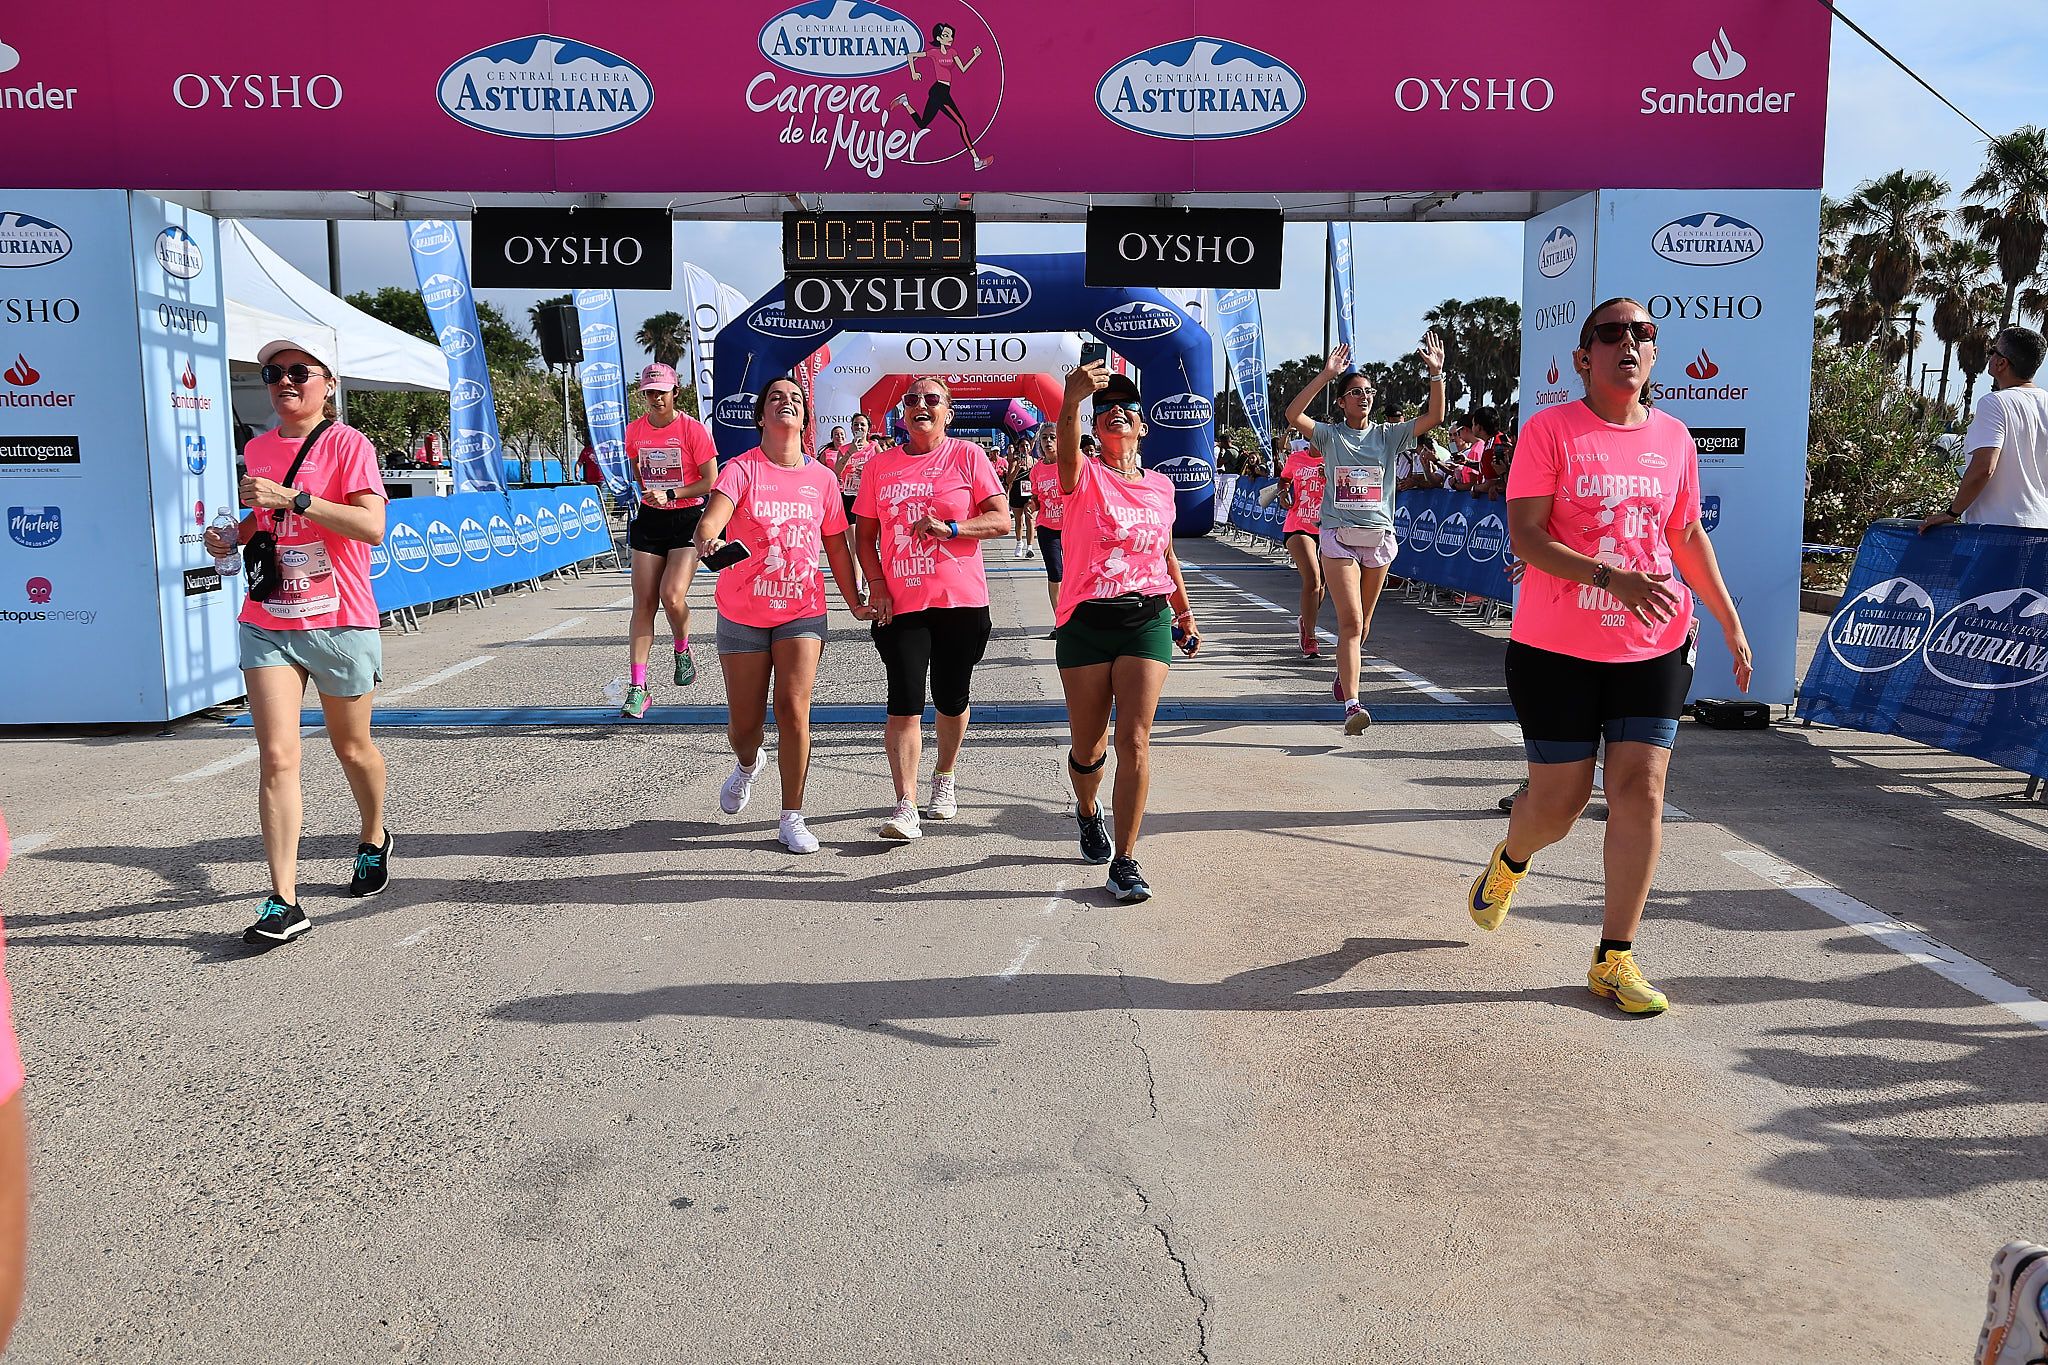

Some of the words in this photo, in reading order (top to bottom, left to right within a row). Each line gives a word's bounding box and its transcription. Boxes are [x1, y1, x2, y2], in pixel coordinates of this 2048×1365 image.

[771, 26, 911, 57] ASTURIANA
[486, 70, 553, 83] CENTRAL
[562, 73, 630, 83] LECHERA
[1145, 73, 1211, 83] CENTRAL
[1217, 73, 1283, 83] LECHERA
[0, 82, 78, 109] nder
[172, 74, 343, 110] OYSHO
[455, 74, 637, 112] ASTURIANA
[746, 71, 881, 113] Carrera
[1112, 75, 1289, 114] ASTURIANA
[1395, 77, 1554, 112] OYSHO
[1640, 86, 1796, 115] Santander
[779, 116, 804, 143] de
[810, 115, 828, 144] la
[824, 110, 931, 178] Mujer
[797, 220, 960, 259] 00:36:53
[1118, 233, 1255, 264] OYSHO
[1660, 231, 1755, 253] ASTURIANA
[159, 241, 200, 270] ASTURIANA
[504, 236, 642, 266] OYSHO
[1540, 246, 1574, 269] ASTURIANA
[794, 277, 968, 313] OYSHO
[0, 299, 80, 323] SHO
[159, 303, 207, 333] OYSHO
[1535, 300, 1576, 331] OYSHO
[1648, 295, 1762, 319] OYSHO
[752, 313, 826, 330] ASTURIANA
[1103, 318, 1178, 332] ASTURIANA
[905, 337, 1027, 362] OYSHO
[834, 366, 870, 374] OYSHO
[962, 374, 1017, 383] Santander
[171, 391, 211, 410] Santander
[1536, 389, 1569, 406] Santander
[1653, 384, 1748, 400] Santander
[1155, 407, 1210, 420] ASTURIANA
[1570, 453, 1609, 462] OYSHO
[651, 467, 667, 475] 016
[880, 483, 935, 500] CARRERA
[1350, 486, 1368, 494] 016
[1576, 475, 1662, 499] CARRERA
[754, 501, 813, 519] CARRERA
[1105, 503, 1161, 525] CARRERA
[1623, 506, 1650, 539] DE
[786, 525, 804, 548] DE
[1132, 529, 1158, 554] DE
[892, 557, 935, 578] MUJER
[185, 573, 220, 590] Neutrogena
[283, 578, 311, 591] 016
[753, 581, 804, 599] MUJER
[905, 577, 921, 587] 2026
[269, 606, 290, 614] OYSHO
[769, 600, 787, 609] 2026
[1860, 608, 1891, 619] CENTRAL
[1892, 610, 1926, 622] LECHERA
[48, 610, 97, 624] energy
[1601, 614, 1625, 627] 2026
[1964, 616, 2009, 632] CENTRAL
[1835, 612, 1921, 650] ASTURIANA
